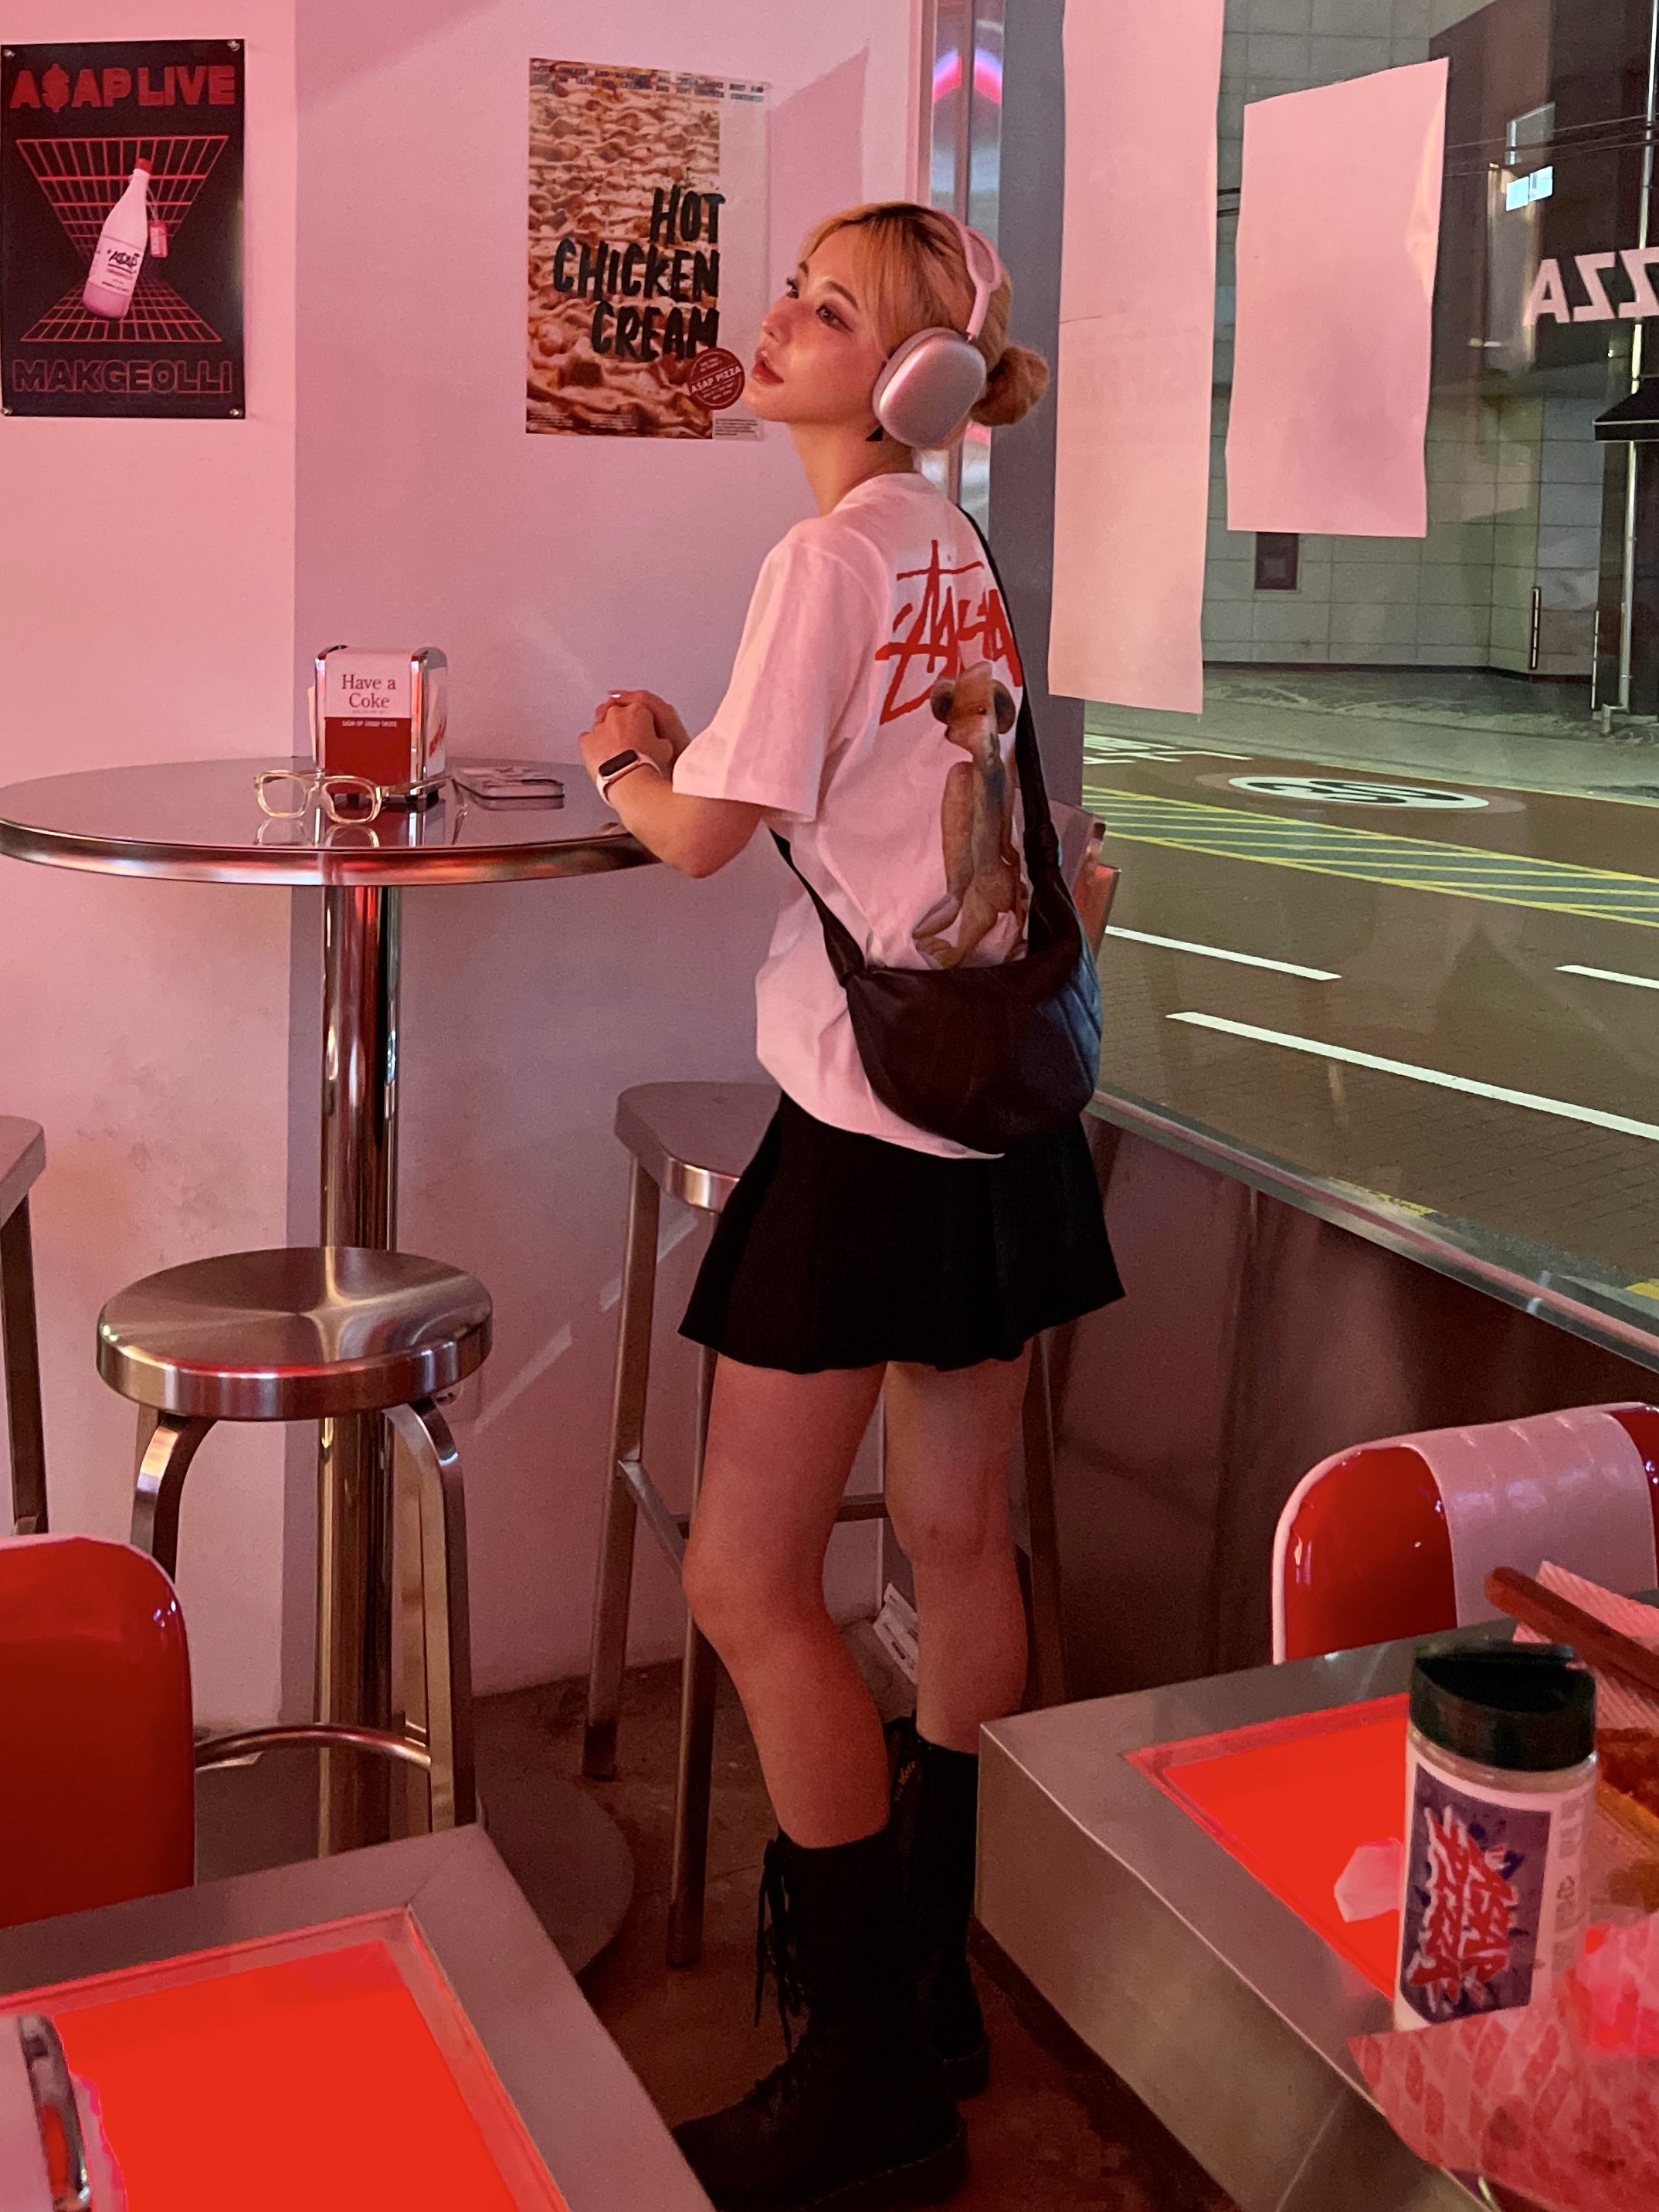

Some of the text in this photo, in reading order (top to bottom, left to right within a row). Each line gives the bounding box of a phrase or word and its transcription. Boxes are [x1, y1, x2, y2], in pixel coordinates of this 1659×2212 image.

[9, 63, 236, 113] A$AP LIVE
[649, 183, 726, 245] HOT
[553, 237, 720, 303] CHICKEN
[590, 300, 720, 362] CREAM
[12, 358, 232, 395] MAKGEOLLI
[714, 365, 742, 382] PIZZA
[341, 674, 397, 690] Have a
[348, 692, 391, 709] Coke
[1247, 780, 1465, 804] 30
